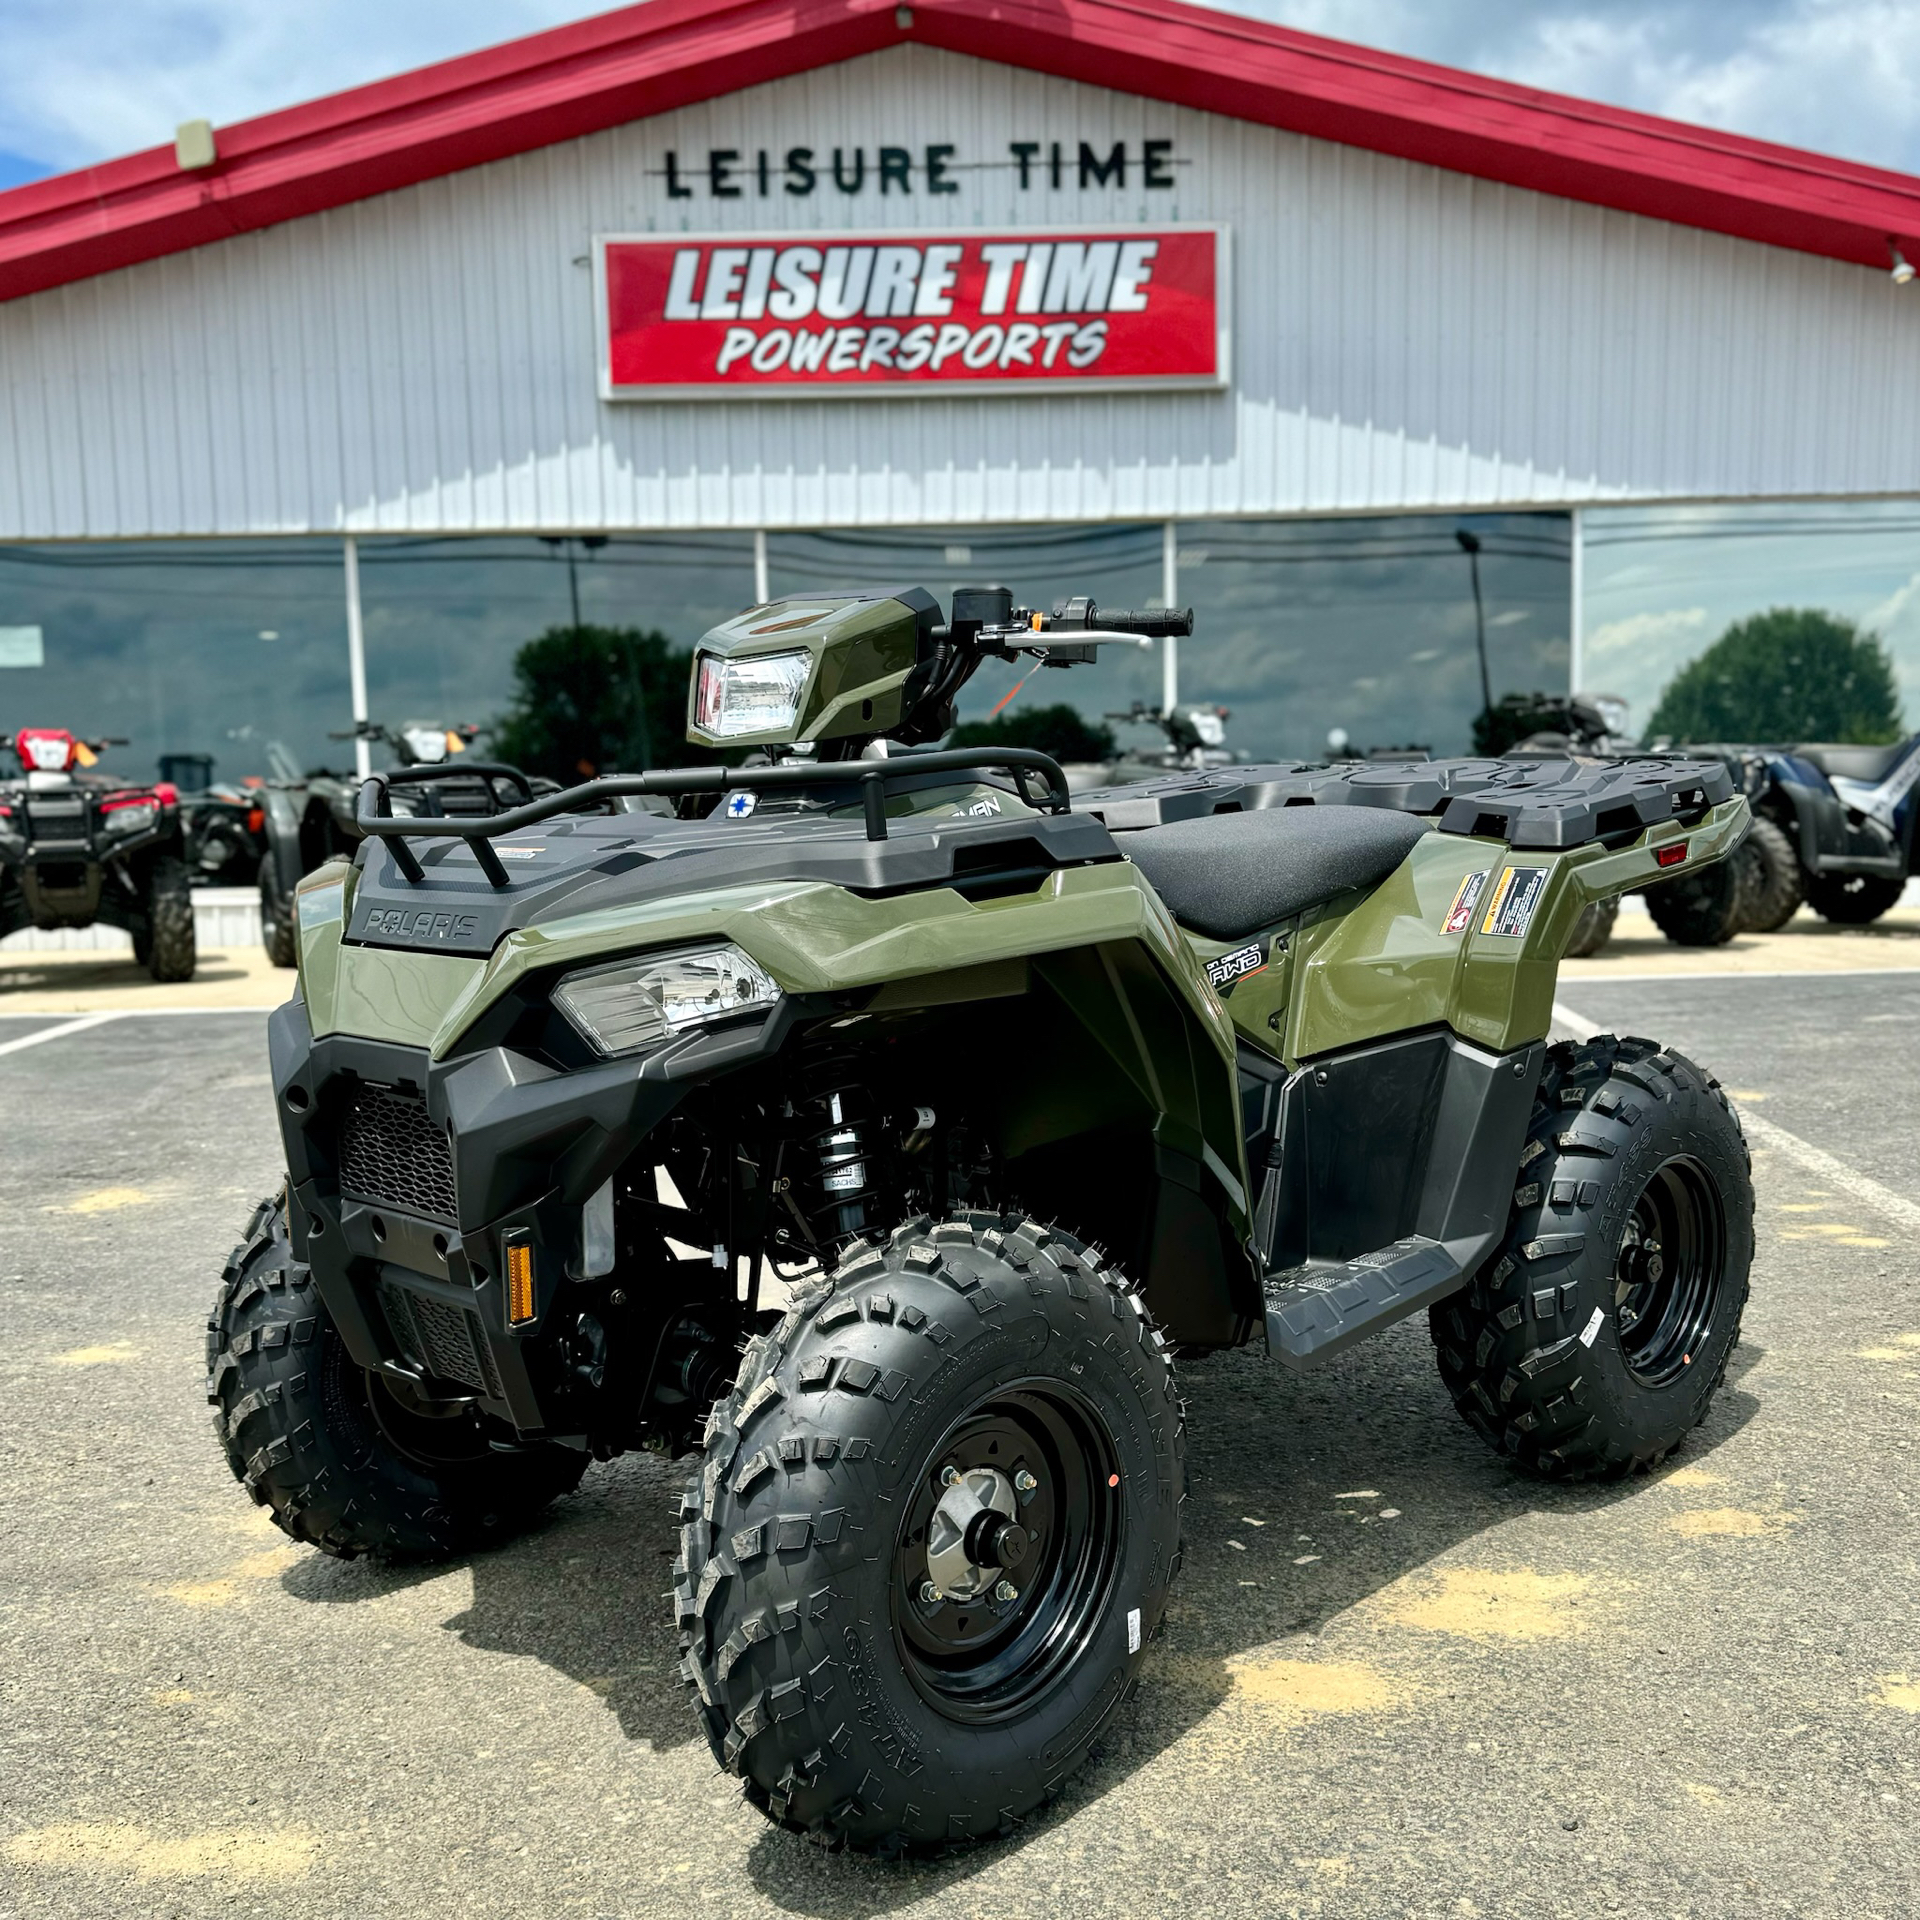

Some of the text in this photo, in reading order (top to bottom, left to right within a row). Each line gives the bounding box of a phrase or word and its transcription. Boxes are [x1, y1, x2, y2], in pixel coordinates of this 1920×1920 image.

[665, 139, 1176, 199] LEISURE TIME
[663, 240, 1159, 321] LEISURE TIME
[716, 321, 1108, 375] POWERSPORTS
[362, 908, 479, 940] POLARIS
[1209, 950, 1262, 986] AWD
[843, 1626, 924, 1778] AT489
